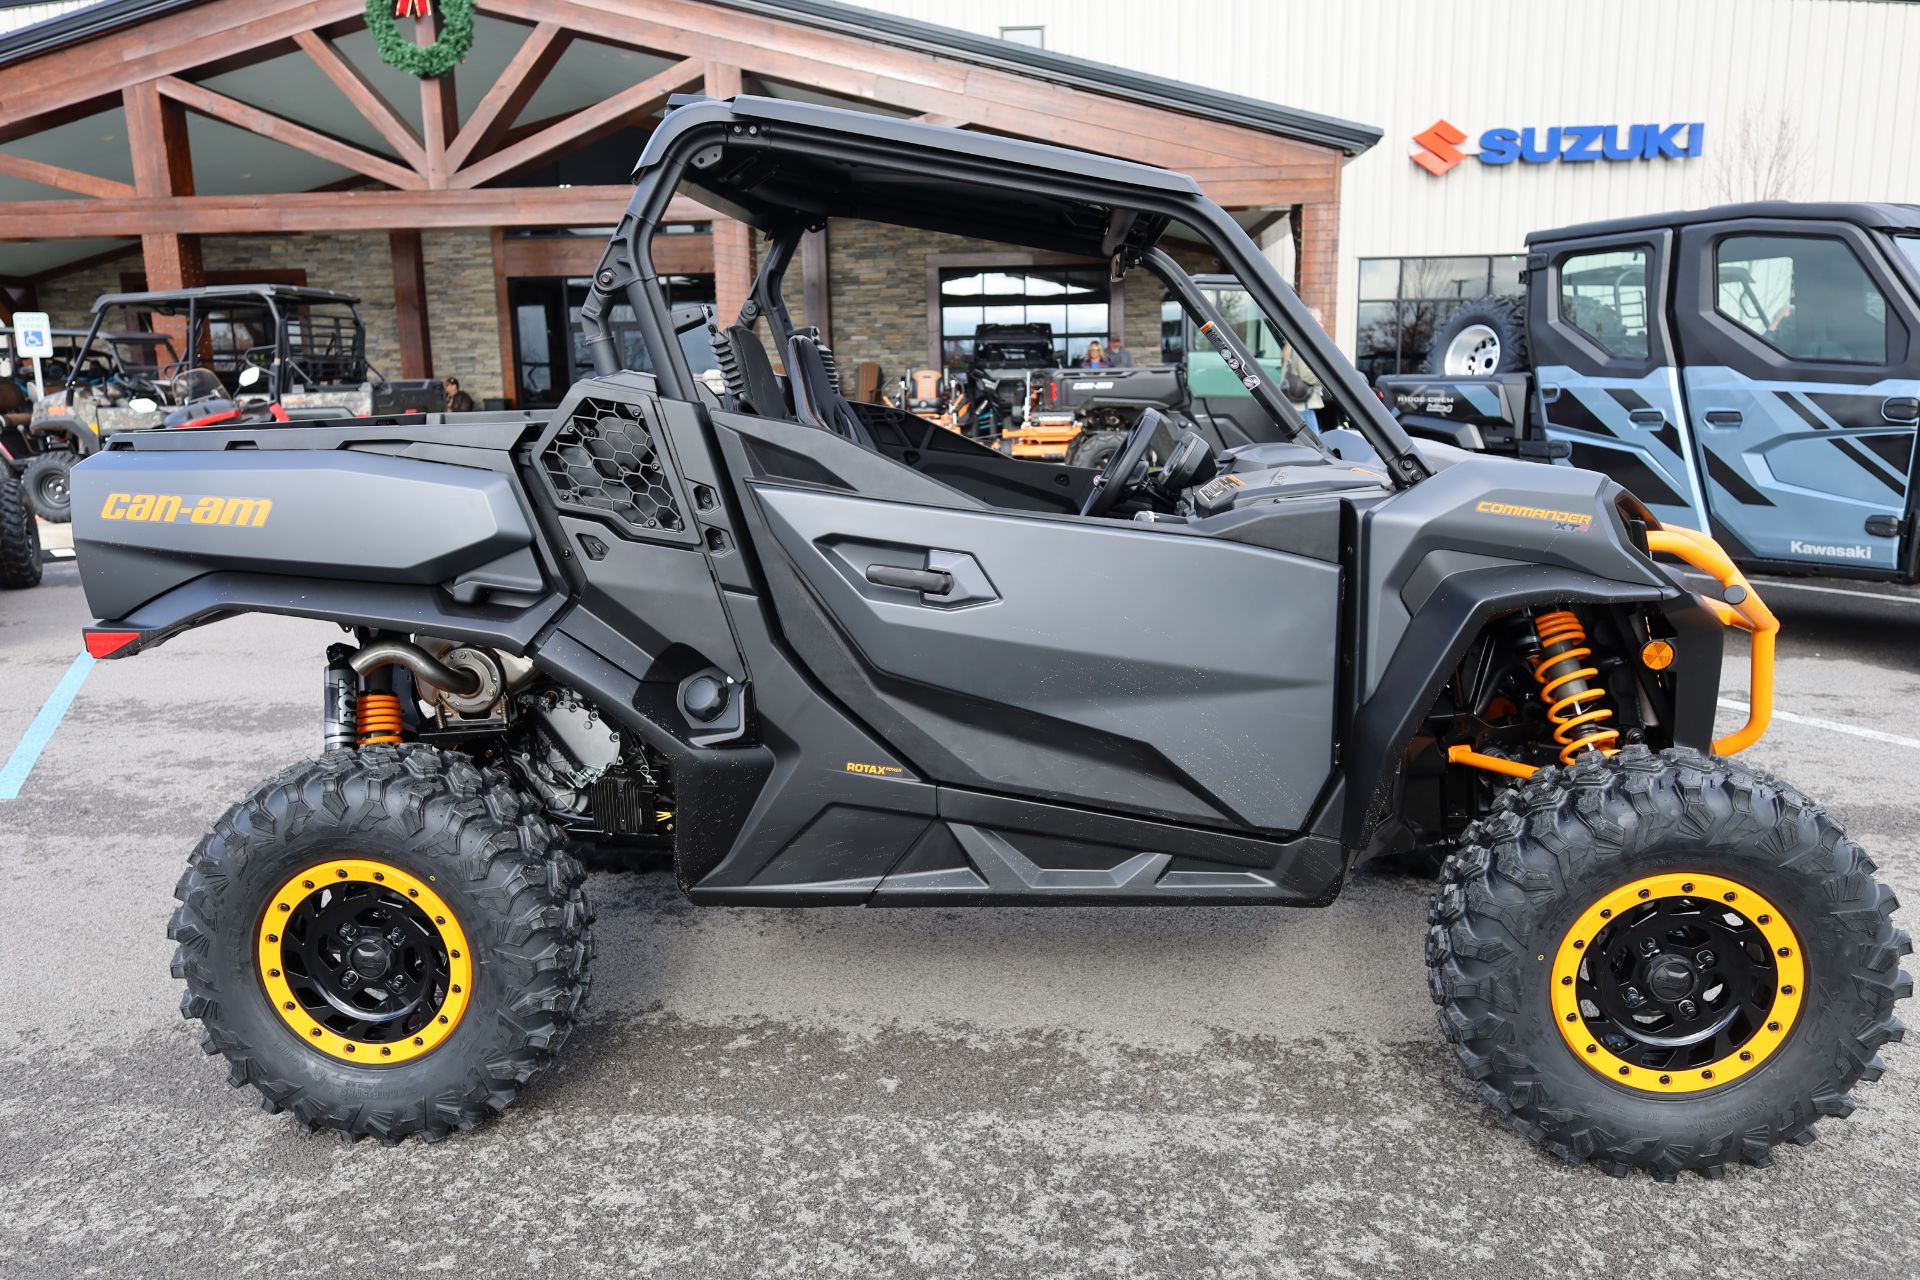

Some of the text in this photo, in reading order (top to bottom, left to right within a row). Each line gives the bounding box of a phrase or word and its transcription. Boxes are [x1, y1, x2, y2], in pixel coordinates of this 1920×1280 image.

[1478, 122, 1705, 165] SUZUKI
[101, 493, 273, 528] can-am
[1477, 501, 1593, 525] COMMANDER
[1790, 540, 1873, 560] Kawasaki
[338, 679, 357, 724] FOX
[846, 762, 886, 775] ROTAX
